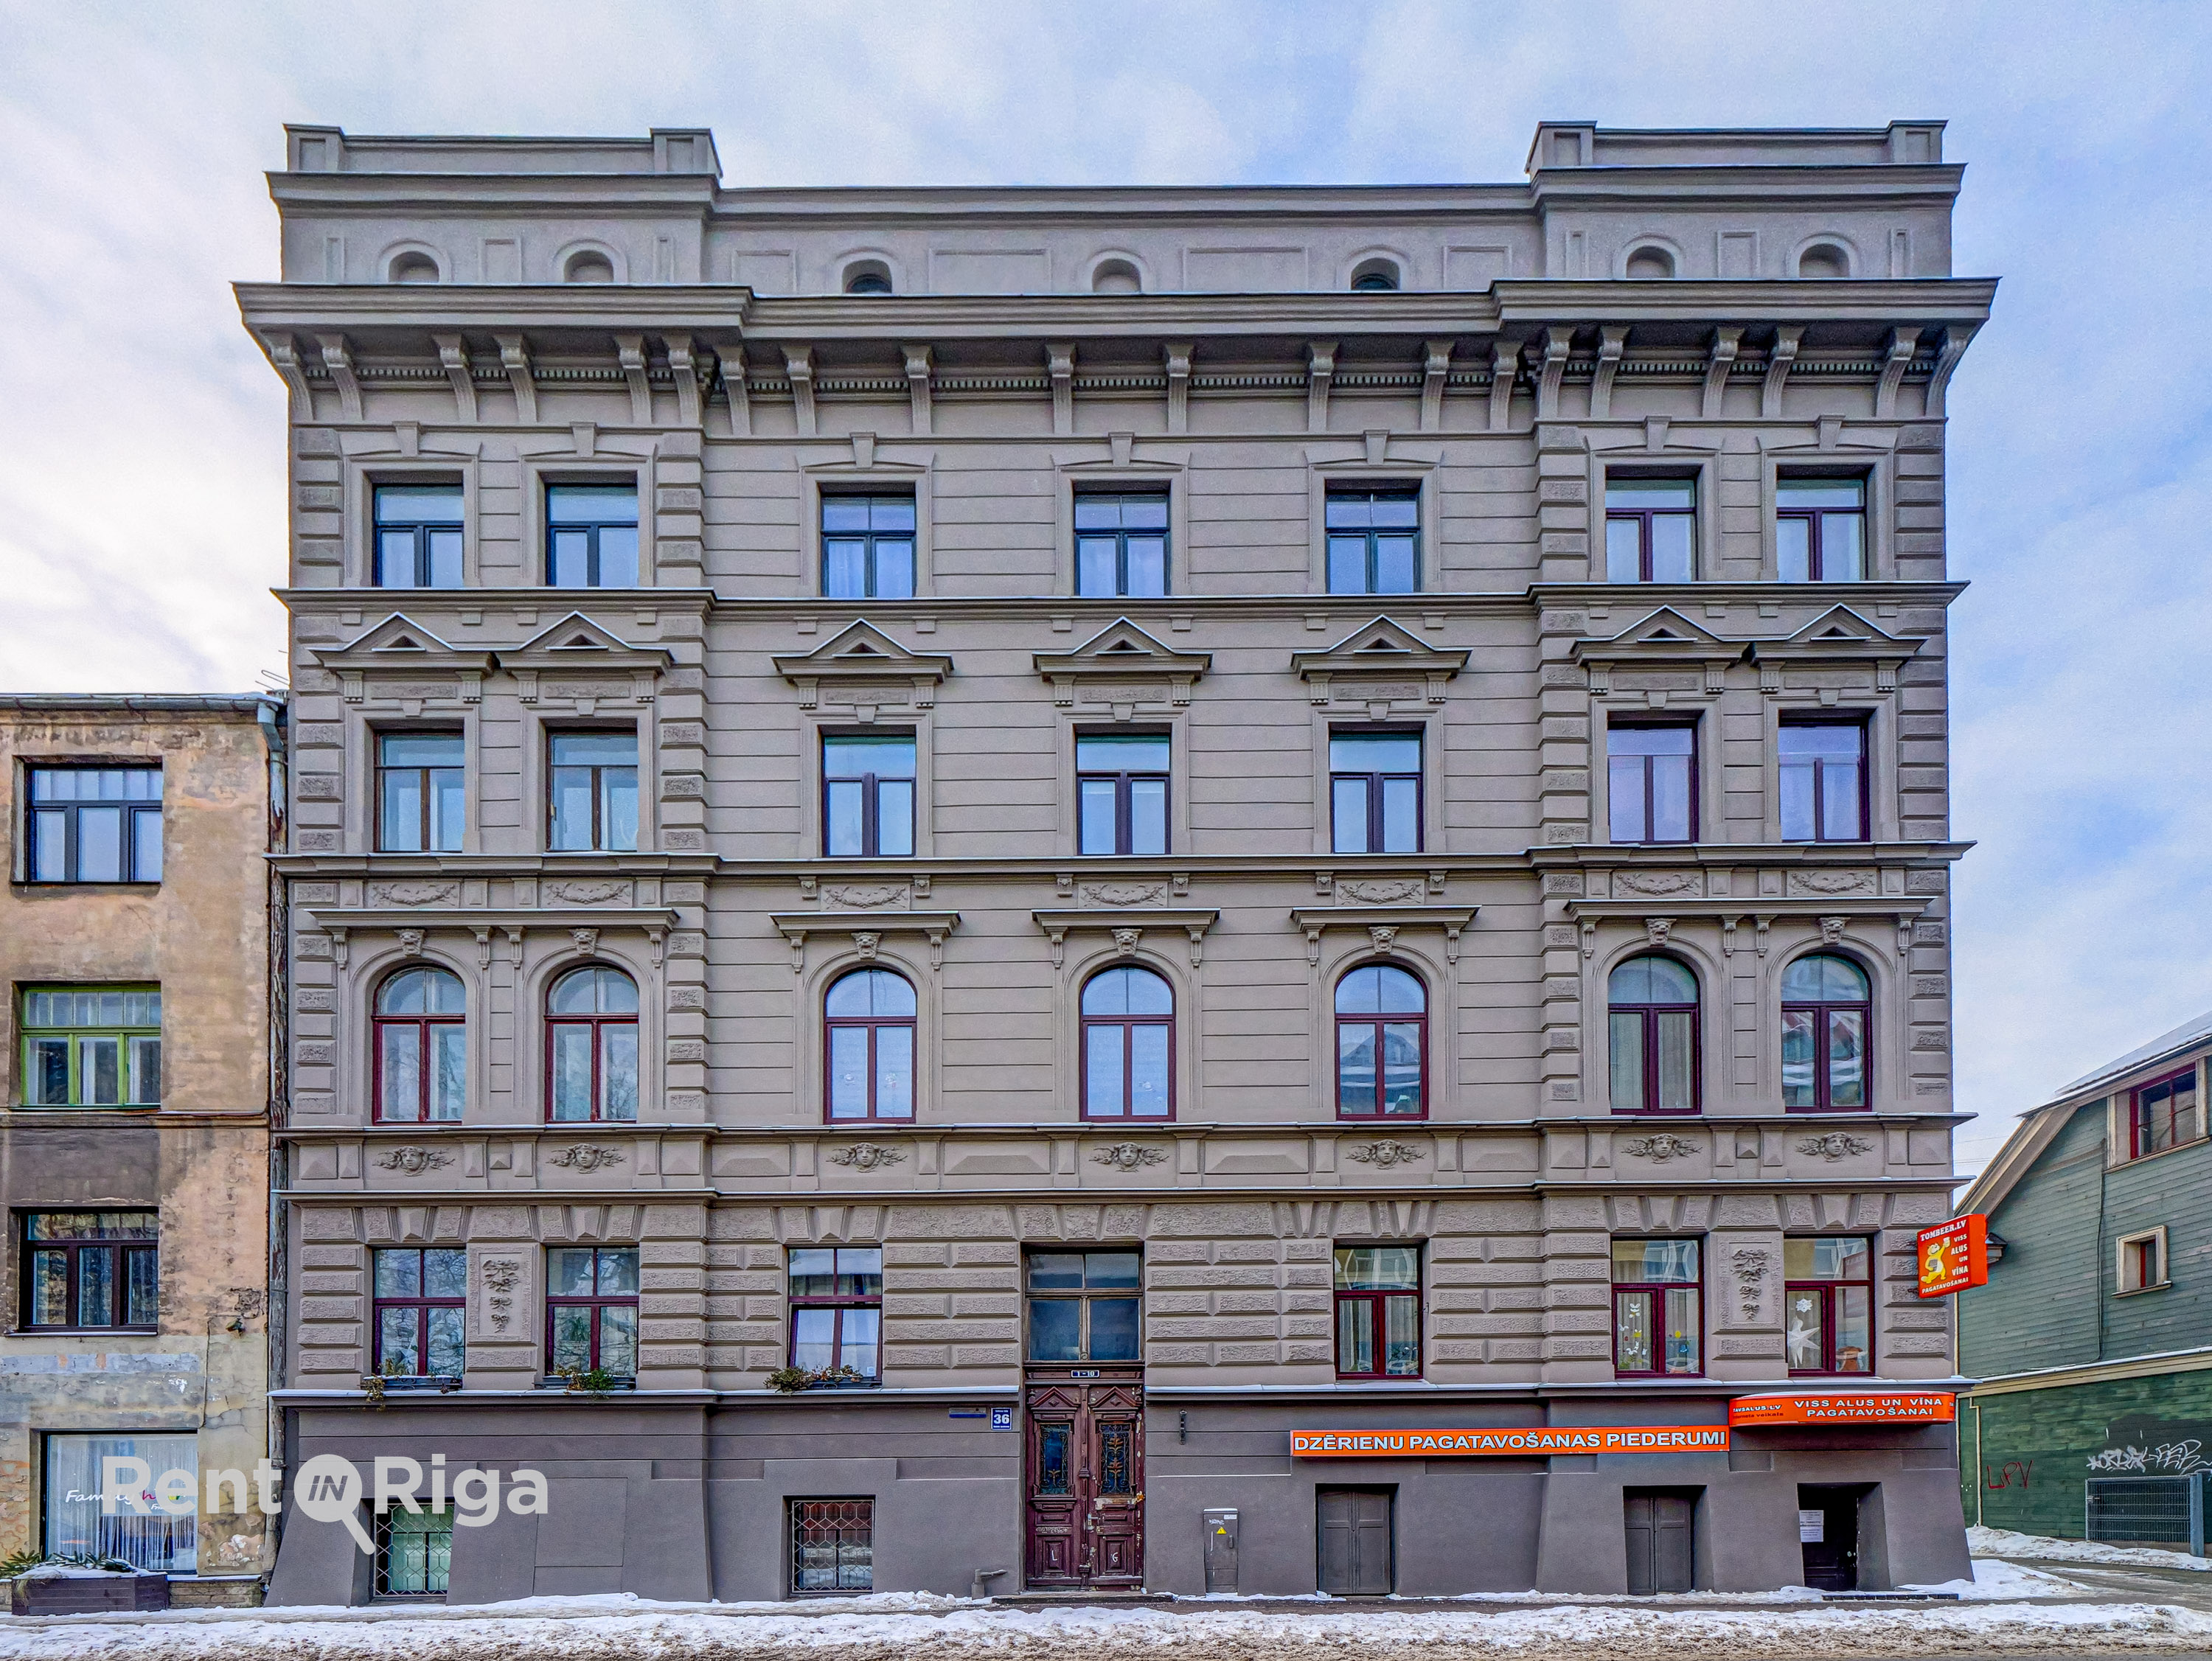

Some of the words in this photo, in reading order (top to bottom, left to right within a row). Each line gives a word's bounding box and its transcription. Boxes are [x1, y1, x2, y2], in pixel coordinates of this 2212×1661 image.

[1920, 1219, 1966, 1242] TOMBEER.LV
[1953, 1233, 1967, 1242] VISS
[1951, 1244, 1968, 1256] ALUS
[1958, 1255, 1968, 1263] UN
[1952, 1265, 1969, 1276] VĪNA
[1921, 1277, 1969, 1294] PAGATAVOŠANAI
[1910, 1397, 1942, 1405] VĪNA
[1733, 1404, 1781, 1413] TAVSALUS.LV
[1806, 1407, 1933, 1417] PAGATAVOŠANAI
[993, 1414, 1009, 1424] 36
[1294, 1434, 1404, 1450] DZĒRIENU
[1410, 1432, 1601, 1449] PAGATAVOŠANAS
[1607, 1432, 1726, 1446] PIEDERUMI
